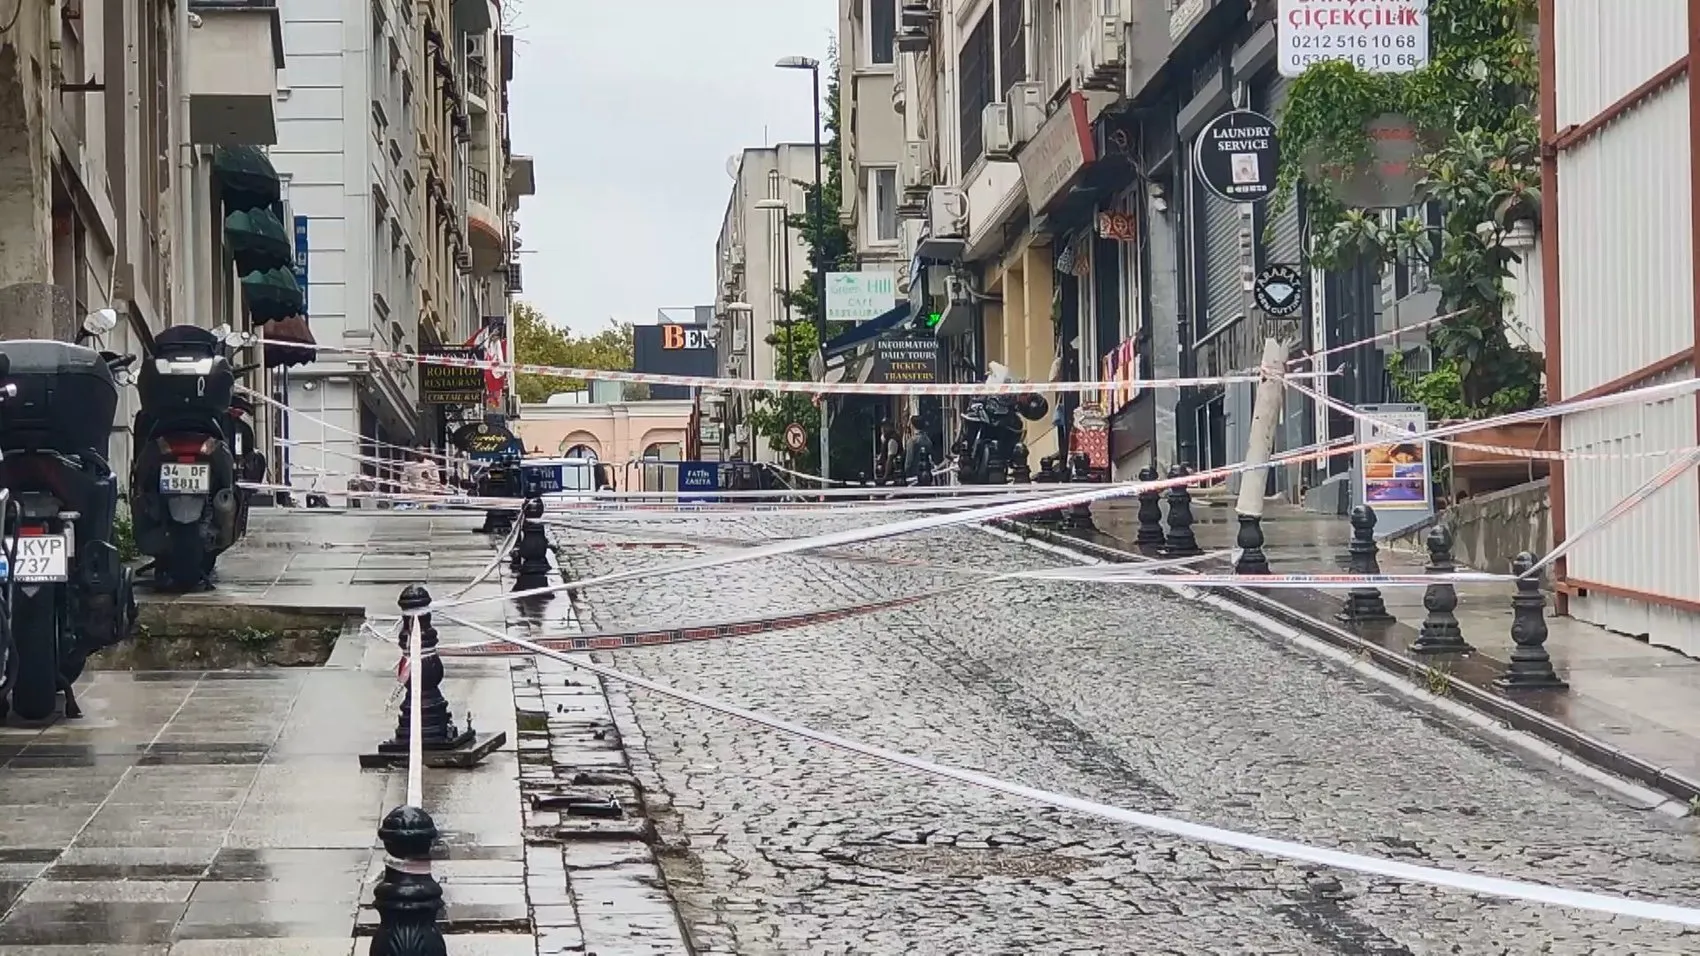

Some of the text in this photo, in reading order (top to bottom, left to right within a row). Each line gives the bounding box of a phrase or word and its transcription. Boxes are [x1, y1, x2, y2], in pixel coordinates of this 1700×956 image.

[1288, 5, 1420, 30] ÇİÇEKÇİLİK
[1292, 35, 1415, 48] 0212 516 10 68
[1373, 54, 1391, 66] 10
[1397, 54, 1415, 66] 68
[1213, 126, 1271, 139] LAUNDRY
[1218, 139, 1268, 151] SERVICE
[1257, 267, 1301, 289] ARARAT
[867, 278, 891, 293] Hill
[1270, 293, 1301, 314] CUTTING
[878, 340, 939, 349] INFORMATION
[881, 351, 936, 360] DAILY TOURS
[891, 362, 927, 371] TICKETS
[884, 372, 935, 381] TRANSFERS
[163, 465, 206, 477] 34 DF
[23, 539, 62, 556] KYP
[16, 557, 50, 574] 737
